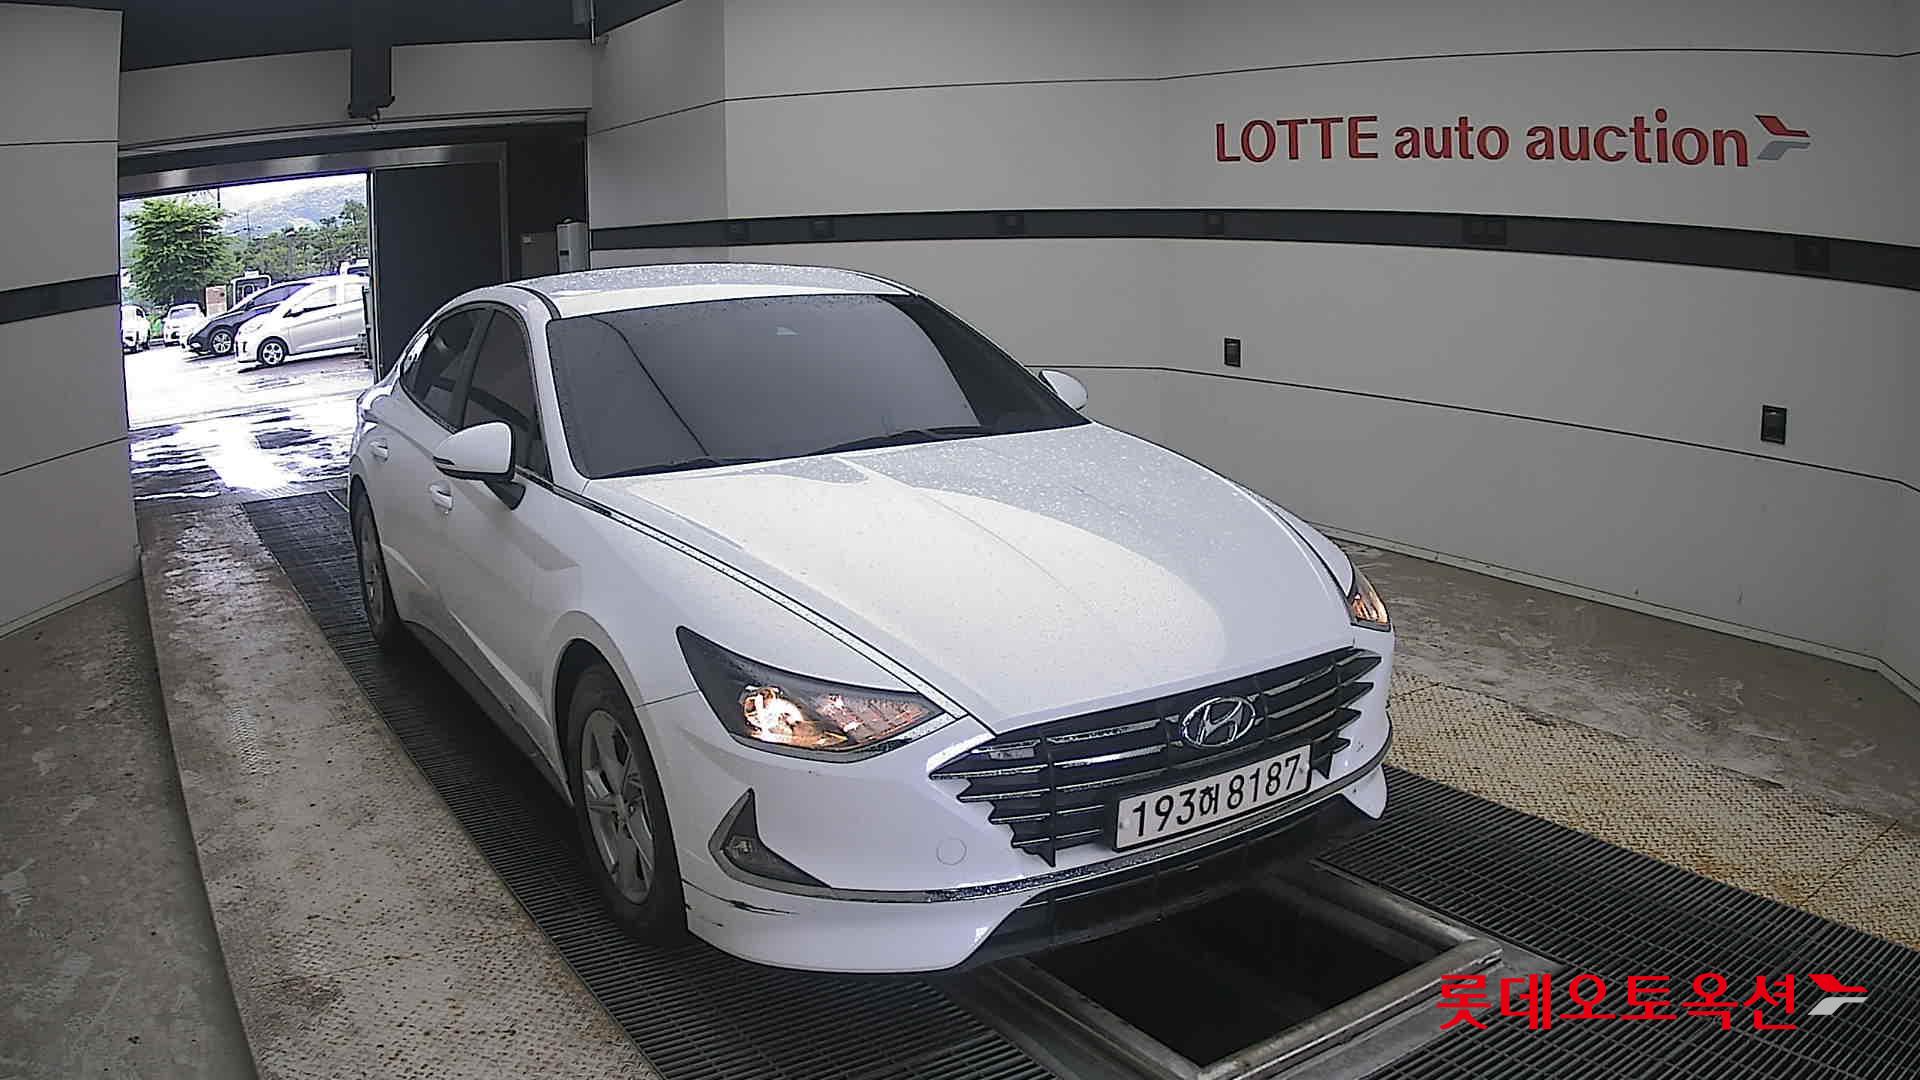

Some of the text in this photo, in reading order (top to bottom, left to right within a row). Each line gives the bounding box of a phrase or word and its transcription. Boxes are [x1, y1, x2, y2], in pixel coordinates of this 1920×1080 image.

[1215, 108, 1749, 167] LOTTE auto auction
[1132, 753, 1301, 837] 193허 8187
